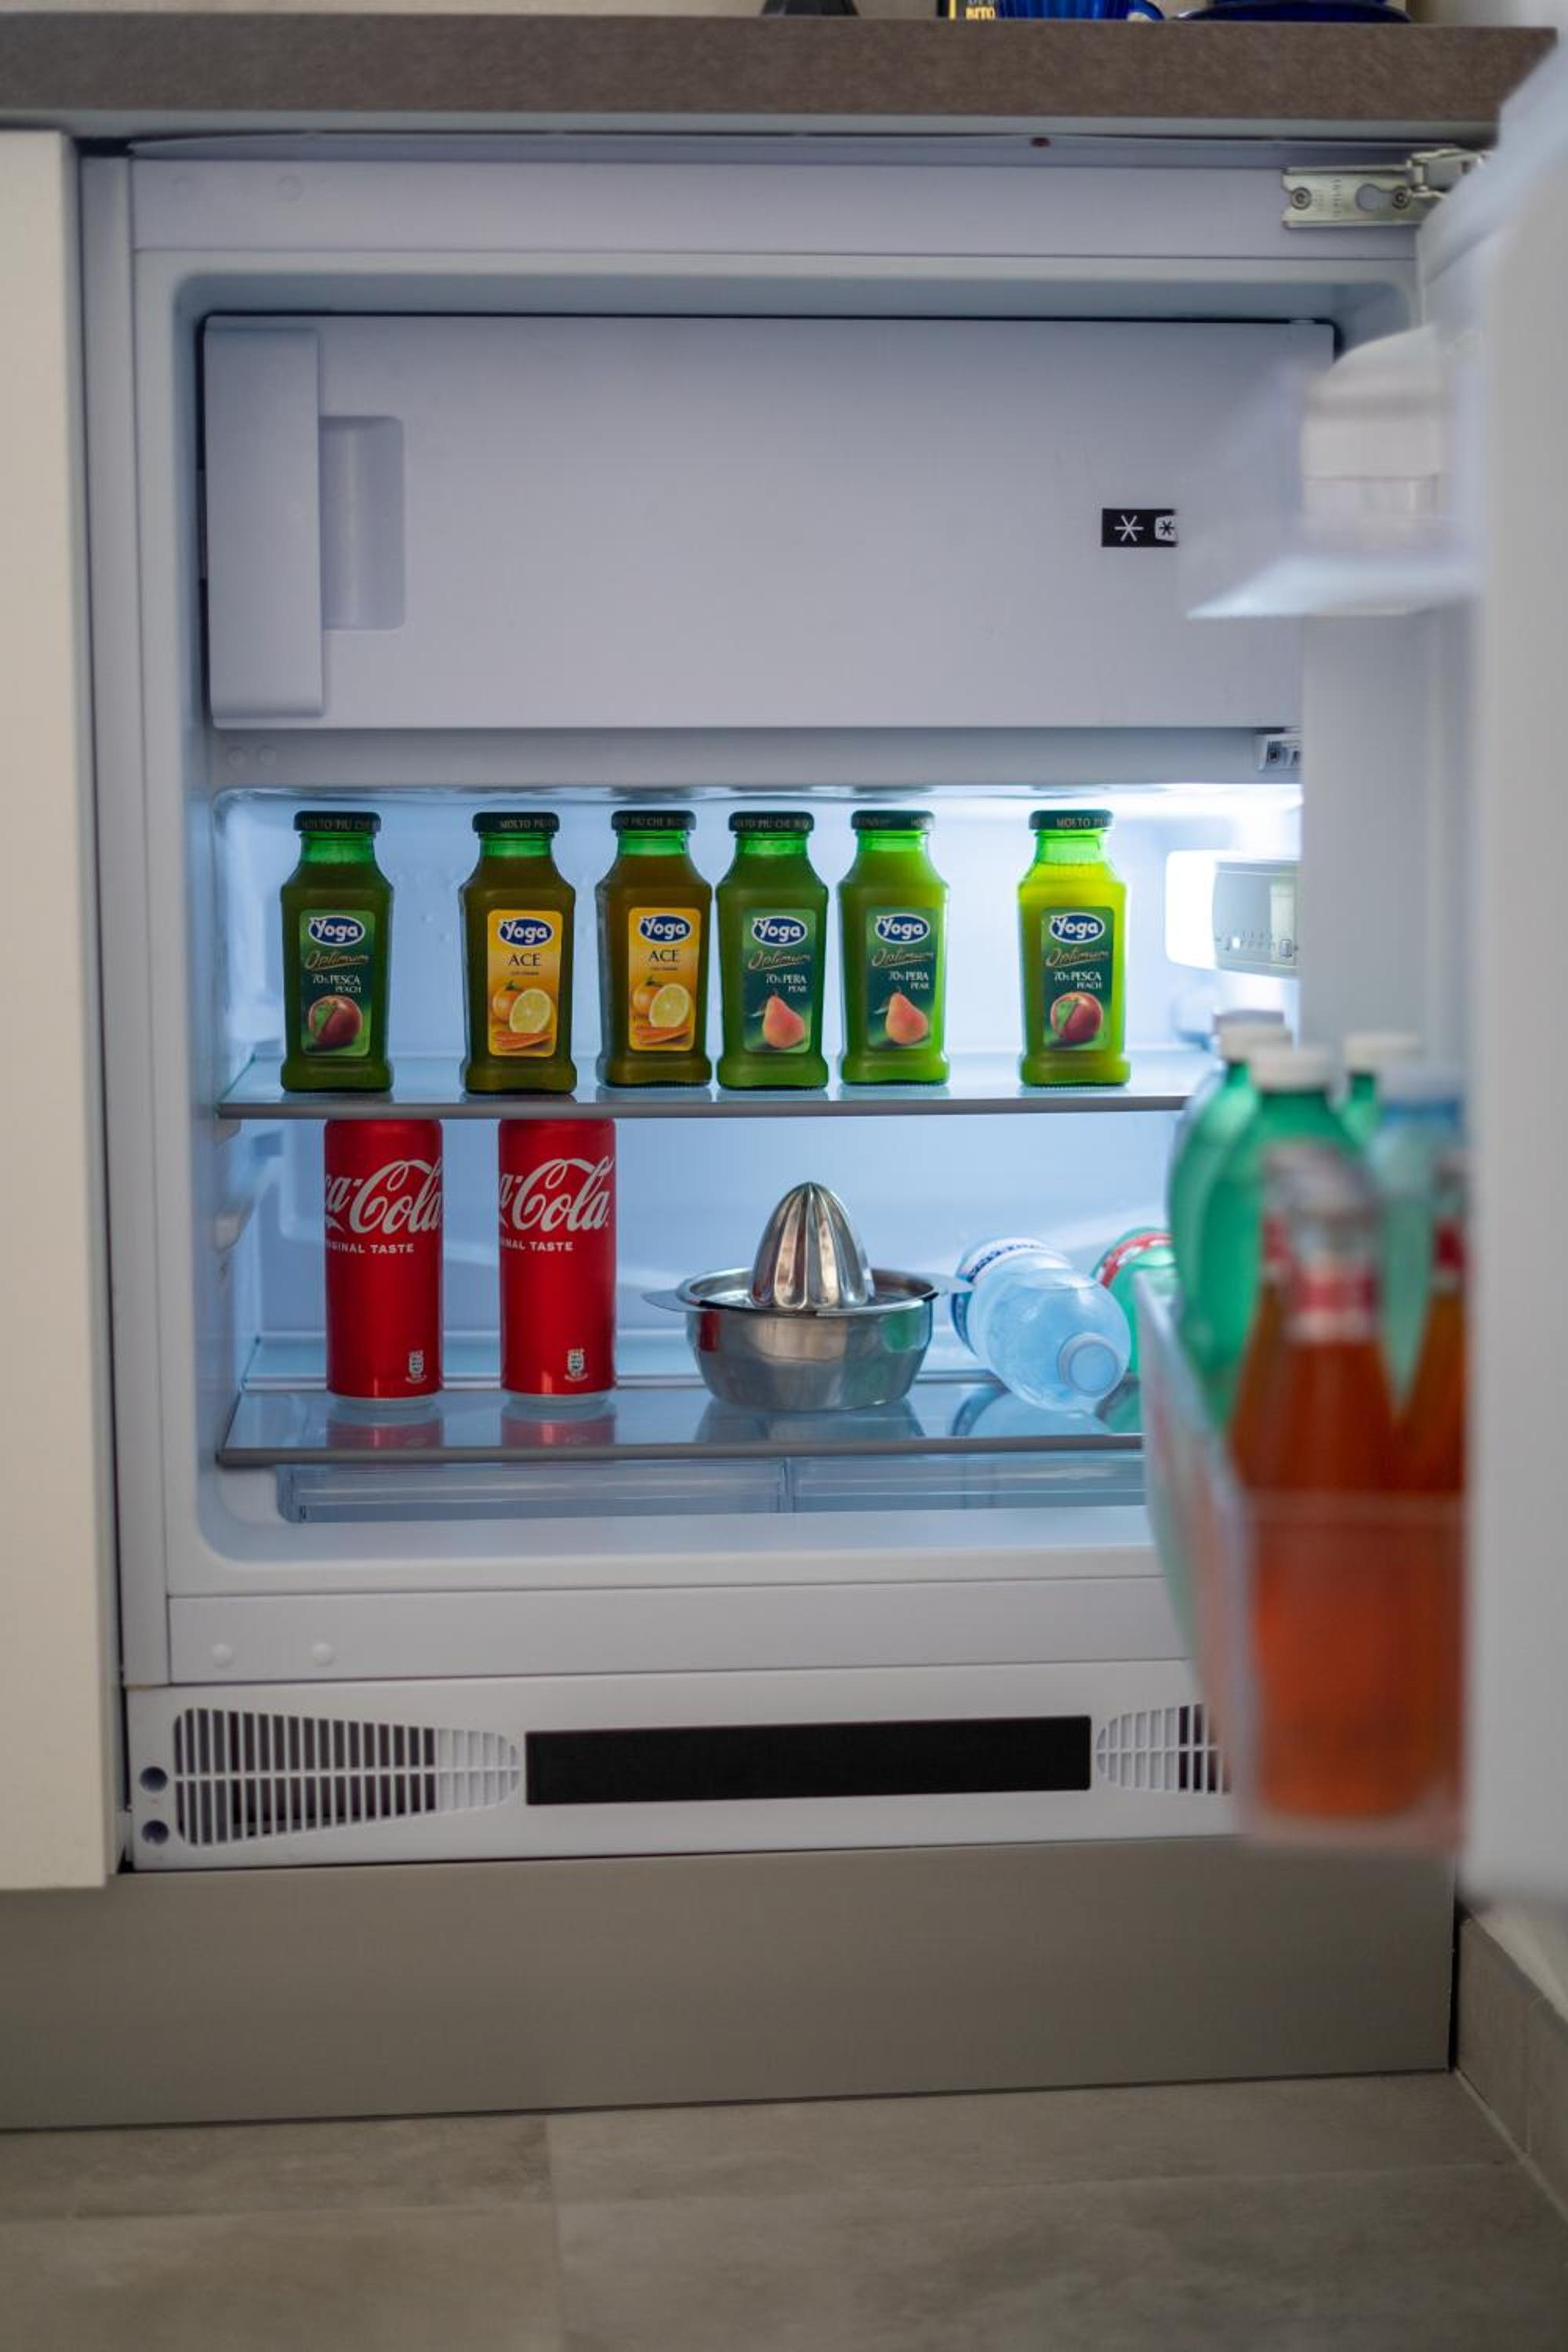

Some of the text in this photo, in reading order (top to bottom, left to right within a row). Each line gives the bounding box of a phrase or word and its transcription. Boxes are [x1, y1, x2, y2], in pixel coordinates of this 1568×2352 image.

[314, 920, 358, 942] Yoga
[504, 921, 547, 943] Yoga
[644, 918, 687, 940] Yoga
[758, 920, 800, 942] Yoga
[882, 918, 924, 940] Yoga
[1055, 916, 1098, 938] Yoga
[509, 953, 541, 966] ACE
[648, 949, 679, 962] ACE
[331, 974, 361, 985] PESCA
[783, 974, 807, 984] PERA
[906, 971, 929, 981] PERA
[1071, 971, 1102, 981] PESCA
[370, 1243, 415, 1254] TASTE
[529, 1241, 574, 1252] TASTE
